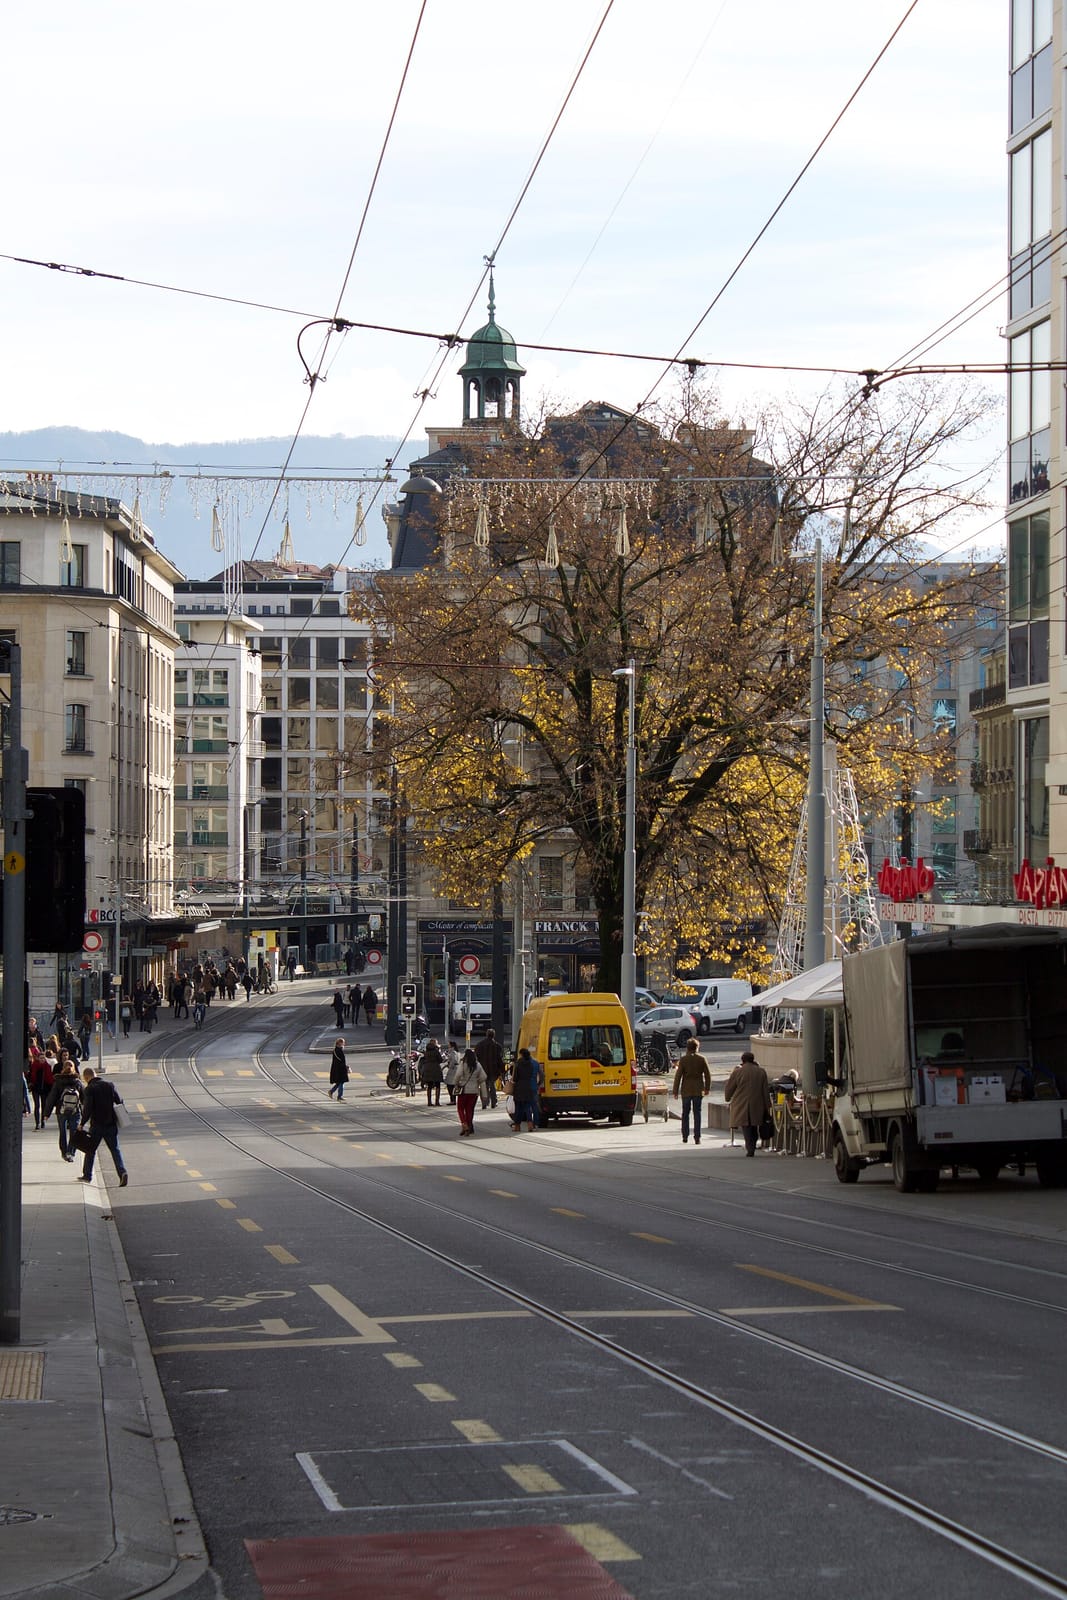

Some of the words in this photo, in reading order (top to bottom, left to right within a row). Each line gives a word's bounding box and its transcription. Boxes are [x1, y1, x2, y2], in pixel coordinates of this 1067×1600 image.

[881, 903, 896, 920] PASTA
[903, 904, 917, 921] PIZZA
[924, 905, 936, 922] BAR
[1019, 910, 1039, 926] PASTA
[536, 921, 590, 931] FRANCK
